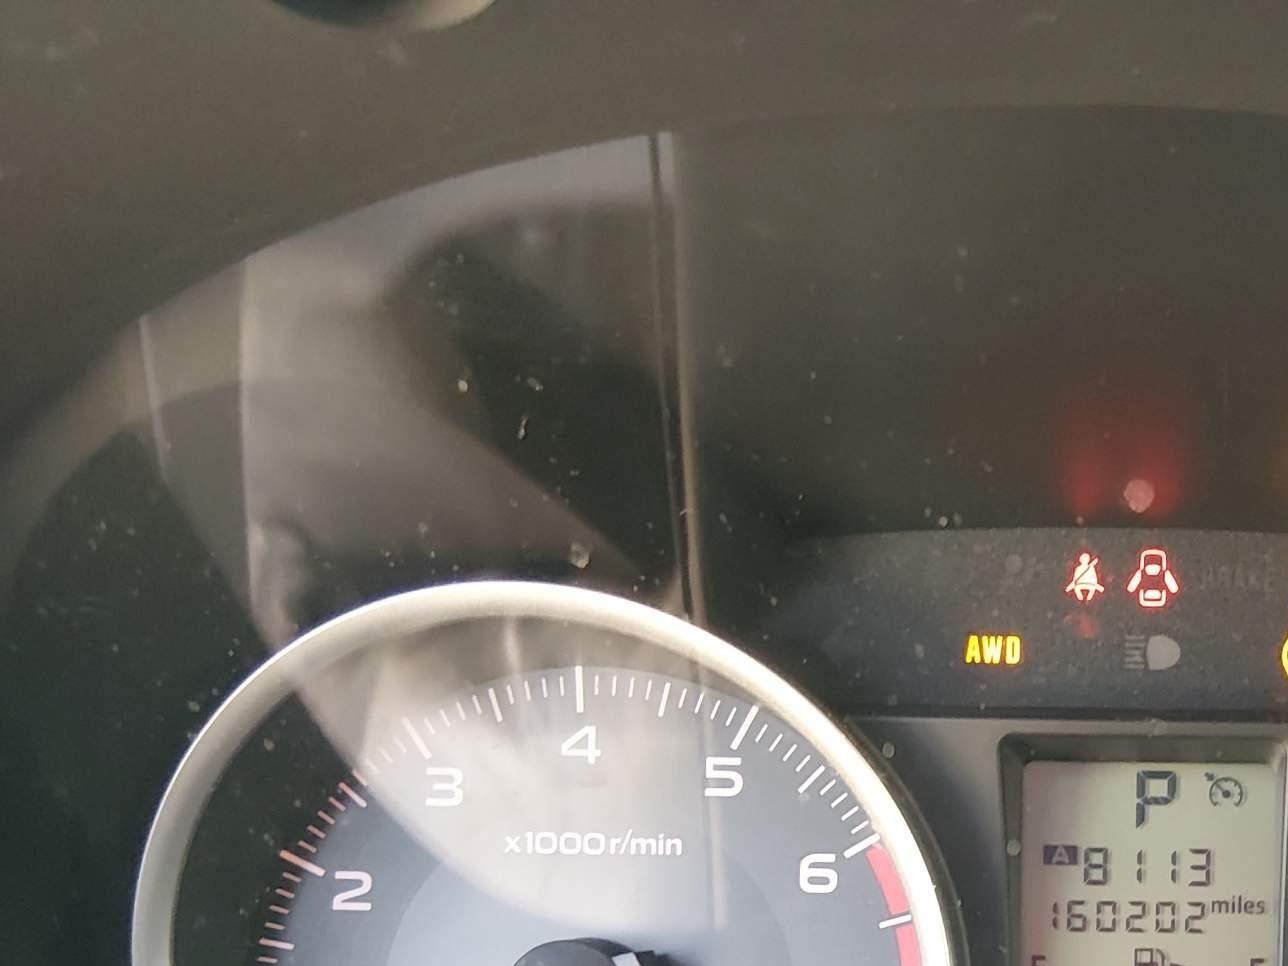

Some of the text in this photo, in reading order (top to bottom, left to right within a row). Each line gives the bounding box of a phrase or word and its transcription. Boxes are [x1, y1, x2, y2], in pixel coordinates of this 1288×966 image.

[965, 635, 1021, 664] AWD
[561, 726, 601, 765] 4
[425, 767, 464, 806] 3
[704, 756, 744, 797] 5
[1135, 770, 1177, 829] P
[799, 853, 839, 893] 6
[1083, 847, 1212, 887] 8113
[332, 870, 373, 911] 2
[1051, 896, 1265, 934] 160202 miles
